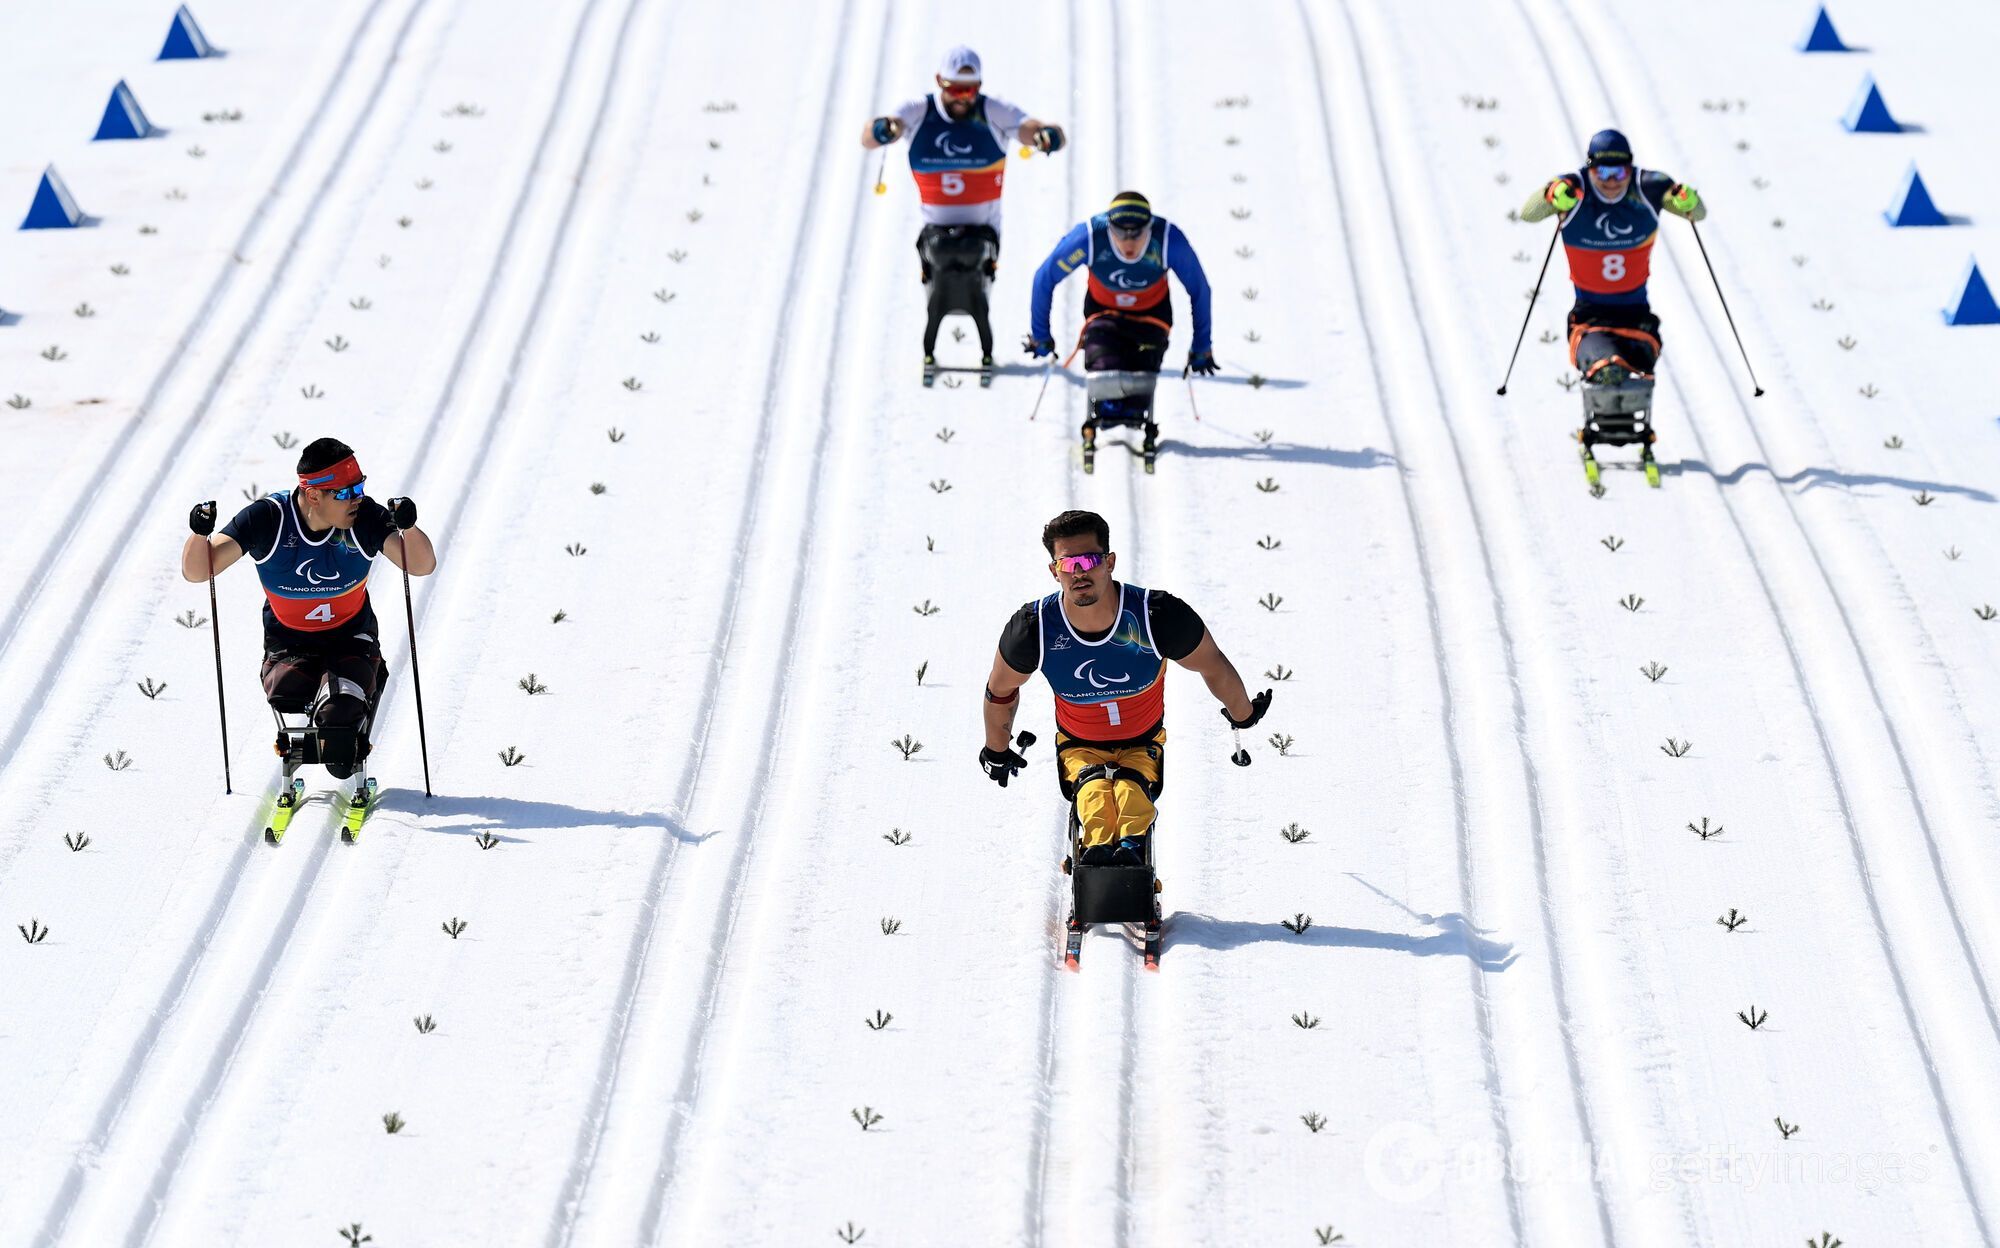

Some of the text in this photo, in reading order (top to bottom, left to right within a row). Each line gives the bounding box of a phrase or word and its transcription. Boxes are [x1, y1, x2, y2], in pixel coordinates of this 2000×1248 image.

[941, 173, 965, 195] 5
[1602, 254, 1626, 282] 8
[305, 603, 335, 622] 4
[1100, 701, 1121, 726] 1
